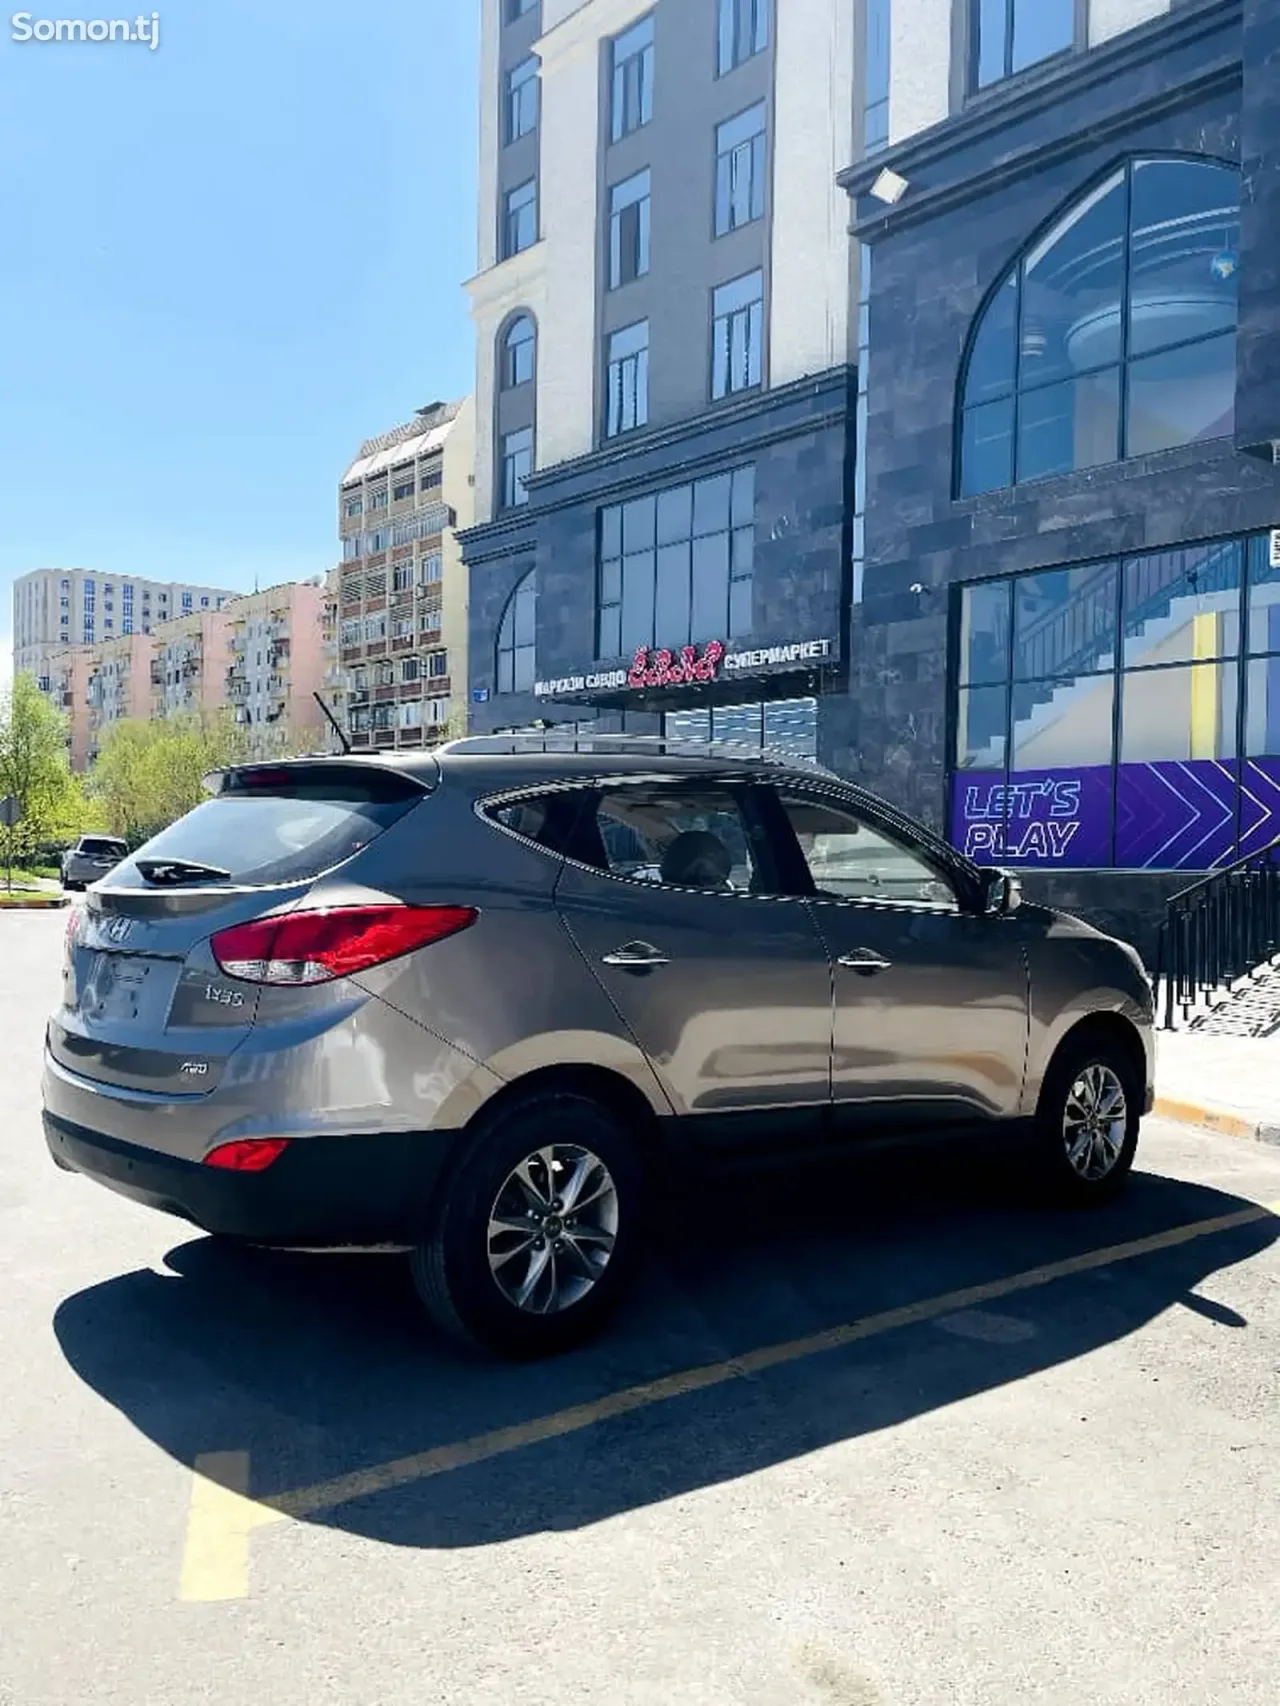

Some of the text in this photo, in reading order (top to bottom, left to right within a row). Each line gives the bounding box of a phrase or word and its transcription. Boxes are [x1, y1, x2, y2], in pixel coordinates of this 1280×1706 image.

[724, 639, 831, 669] СУПЕРМАРКЕТ
[964, 778, 1081, 819] LET'S
[964, 821, 1080, 857] PLAY
